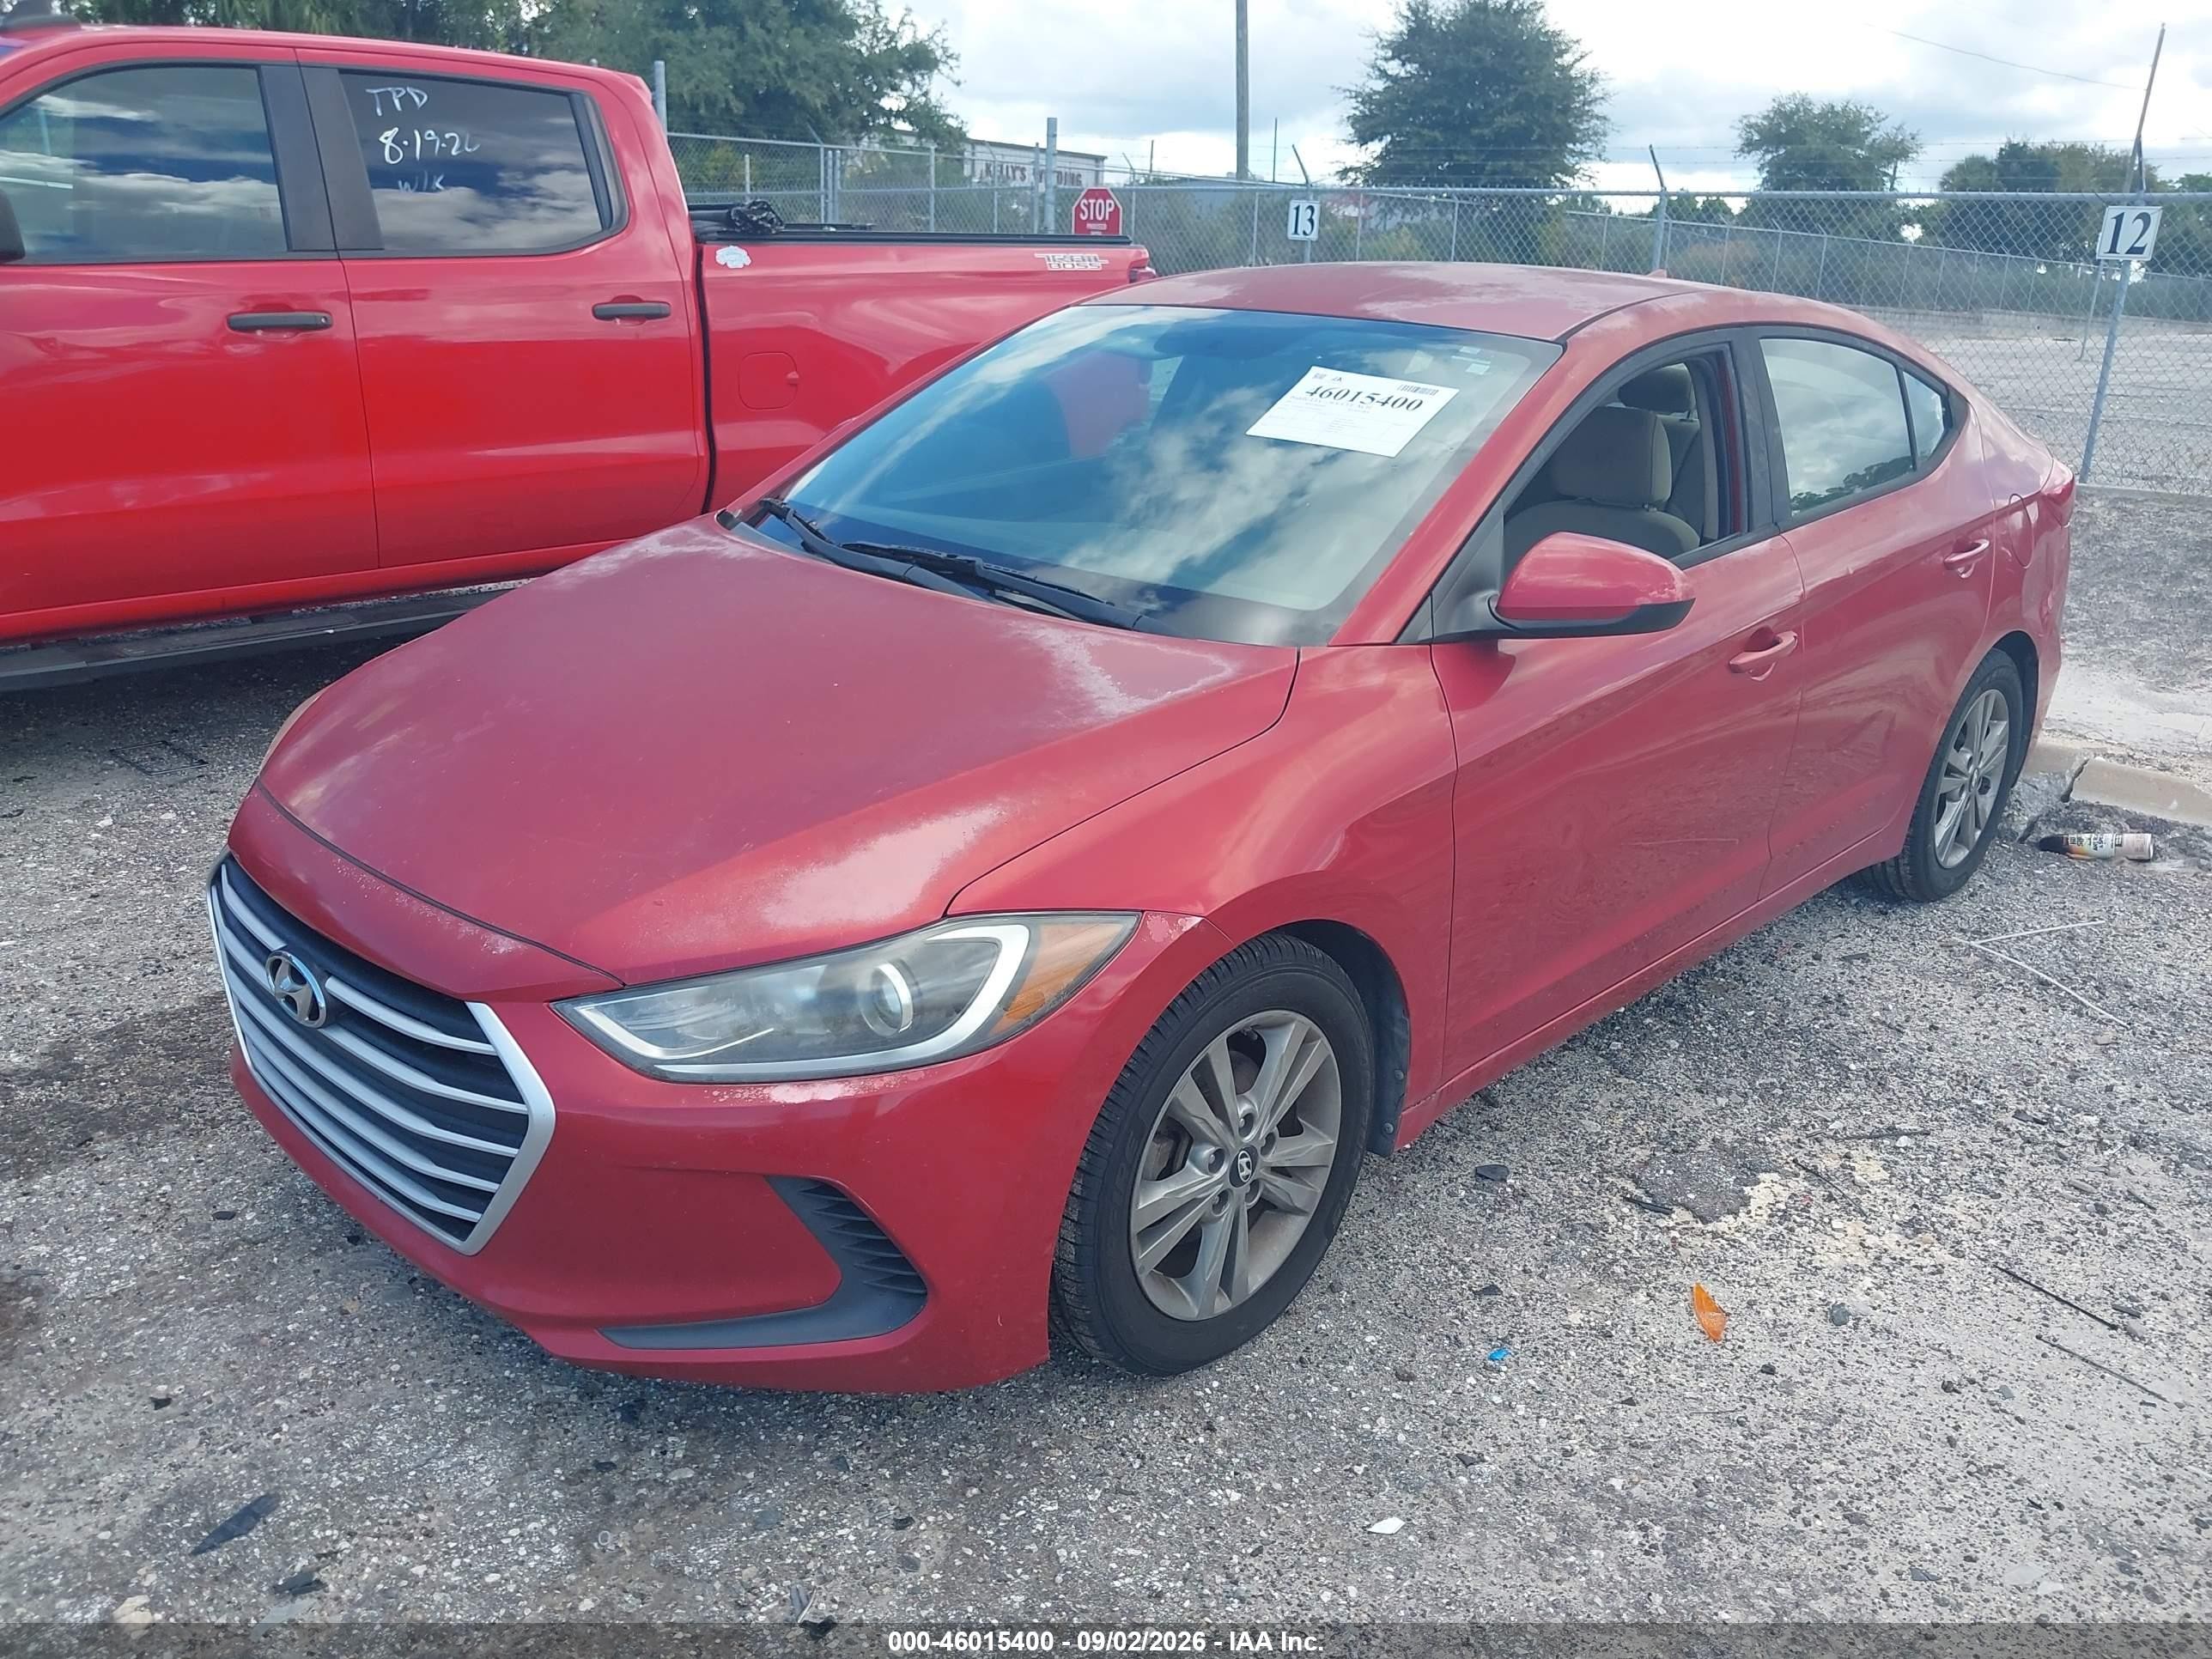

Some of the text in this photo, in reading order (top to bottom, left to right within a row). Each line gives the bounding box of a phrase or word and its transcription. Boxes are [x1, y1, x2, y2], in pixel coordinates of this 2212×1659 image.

[366, 87, 428, 116] TPD
[1079, 198, 1115, 221] STOP
[1291, 204, 1315, 236] 13
[2103, 211, 2151, 255] 12
[1305, 385, 1424, 412] 46015400
